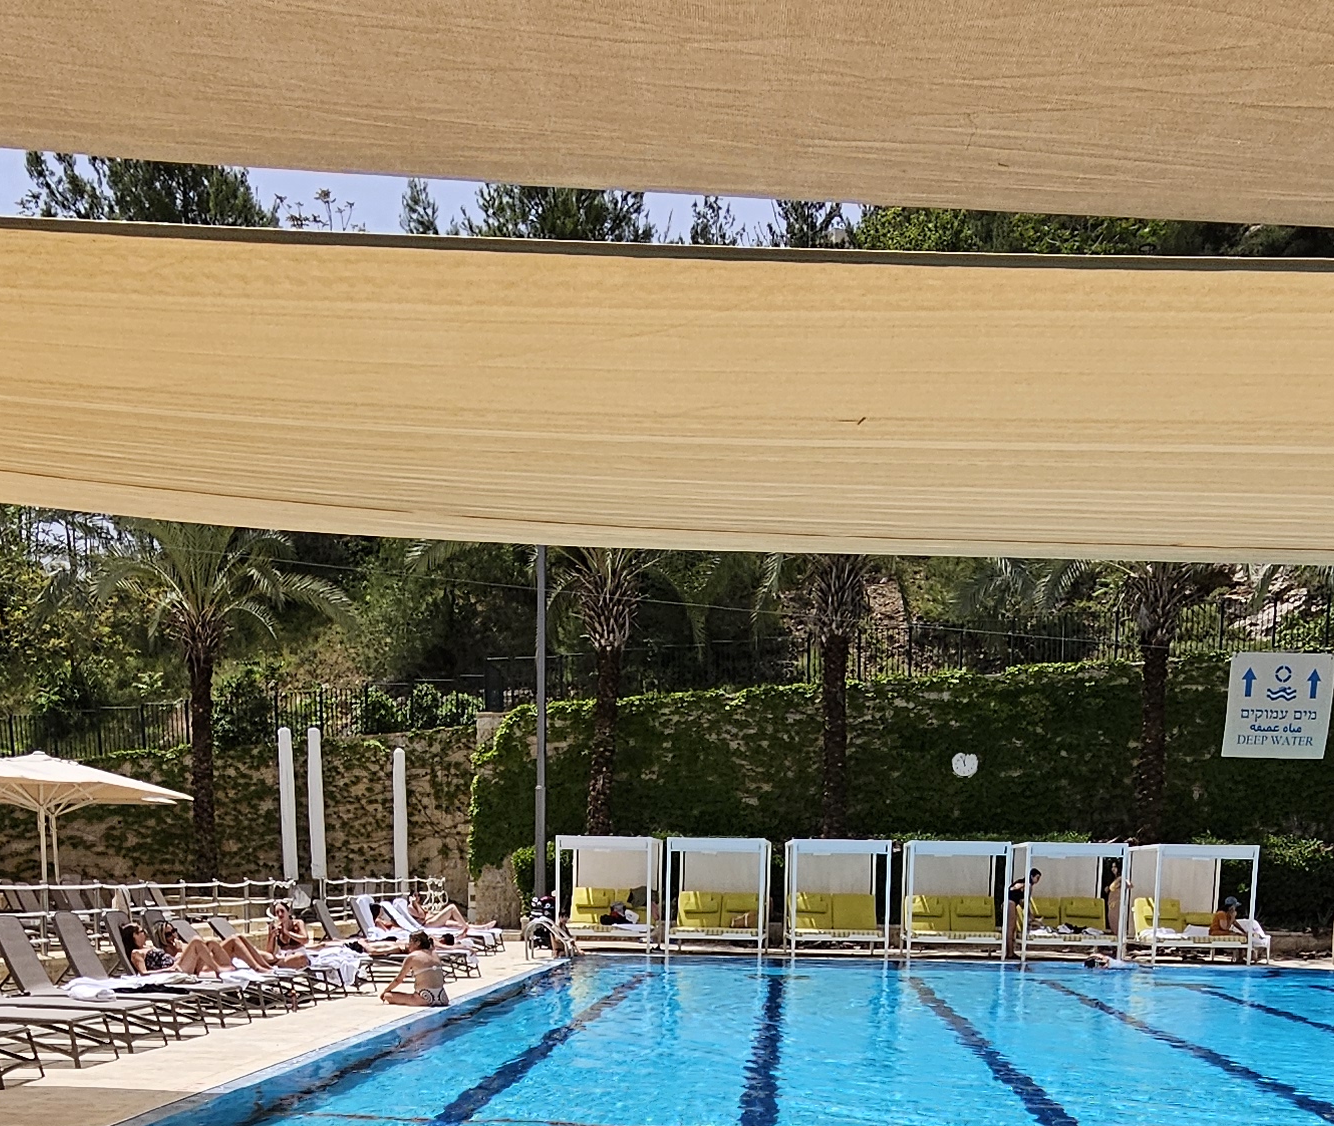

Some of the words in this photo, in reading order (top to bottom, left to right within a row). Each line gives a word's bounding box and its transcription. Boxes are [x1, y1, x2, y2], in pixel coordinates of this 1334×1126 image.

[1240, 709, 1288, 722] עמוקים
[1293, 711, 1317, 720] מים
[1237, 734, 1268, 745] DEEP
[1271, 735, 1313, 746] WATER
